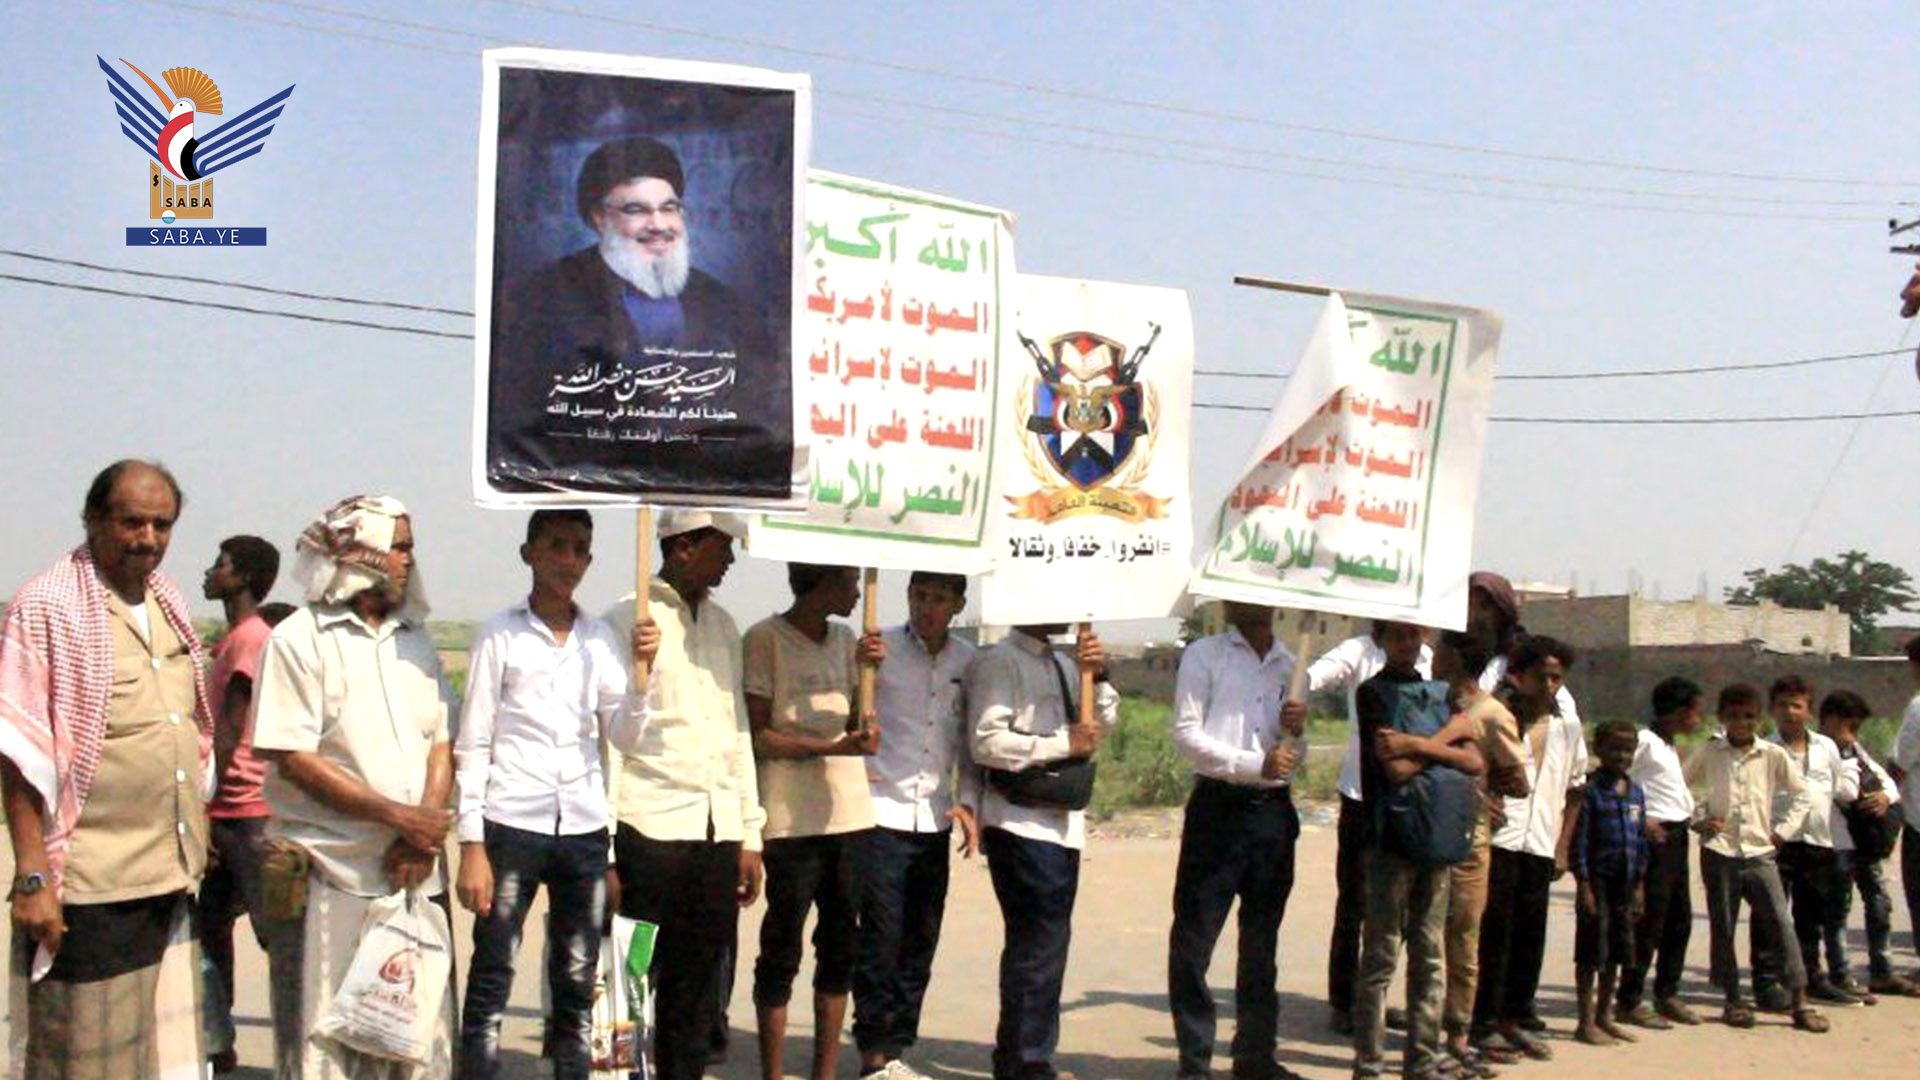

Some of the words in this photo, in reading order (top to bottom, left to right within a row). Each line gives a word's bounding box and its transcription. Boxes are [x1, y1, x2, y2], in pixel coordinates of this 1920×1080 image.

[918, 222, 987, 274] الله
[807, 276, 893, 325] لأمريك
[903, 298, 988, 336] الموت
[1369, 327, 1441, 377] الله
[900, 356, 987, 395] الموت
[546, 402, 569, 415] الله
[570, 404, 604, 418] سبيل
[605, 405, 625, 421] في
[626, 406, 678, 420] الشهادة
[677, 402, 701, 421] لكم
[1351, 393, 1432, 429] الموت
[867, 408, 908, 449] على
[920, 409, 984, 453] اللعنة
[1346, 442, 1423, 480] الموت
[889, 463, 979, 524] النصر
[1306, 486, 1345, 520] على
[1356, 489, 1417, 530] اللعنة
[1322, 538, 1413, 585] النصر
